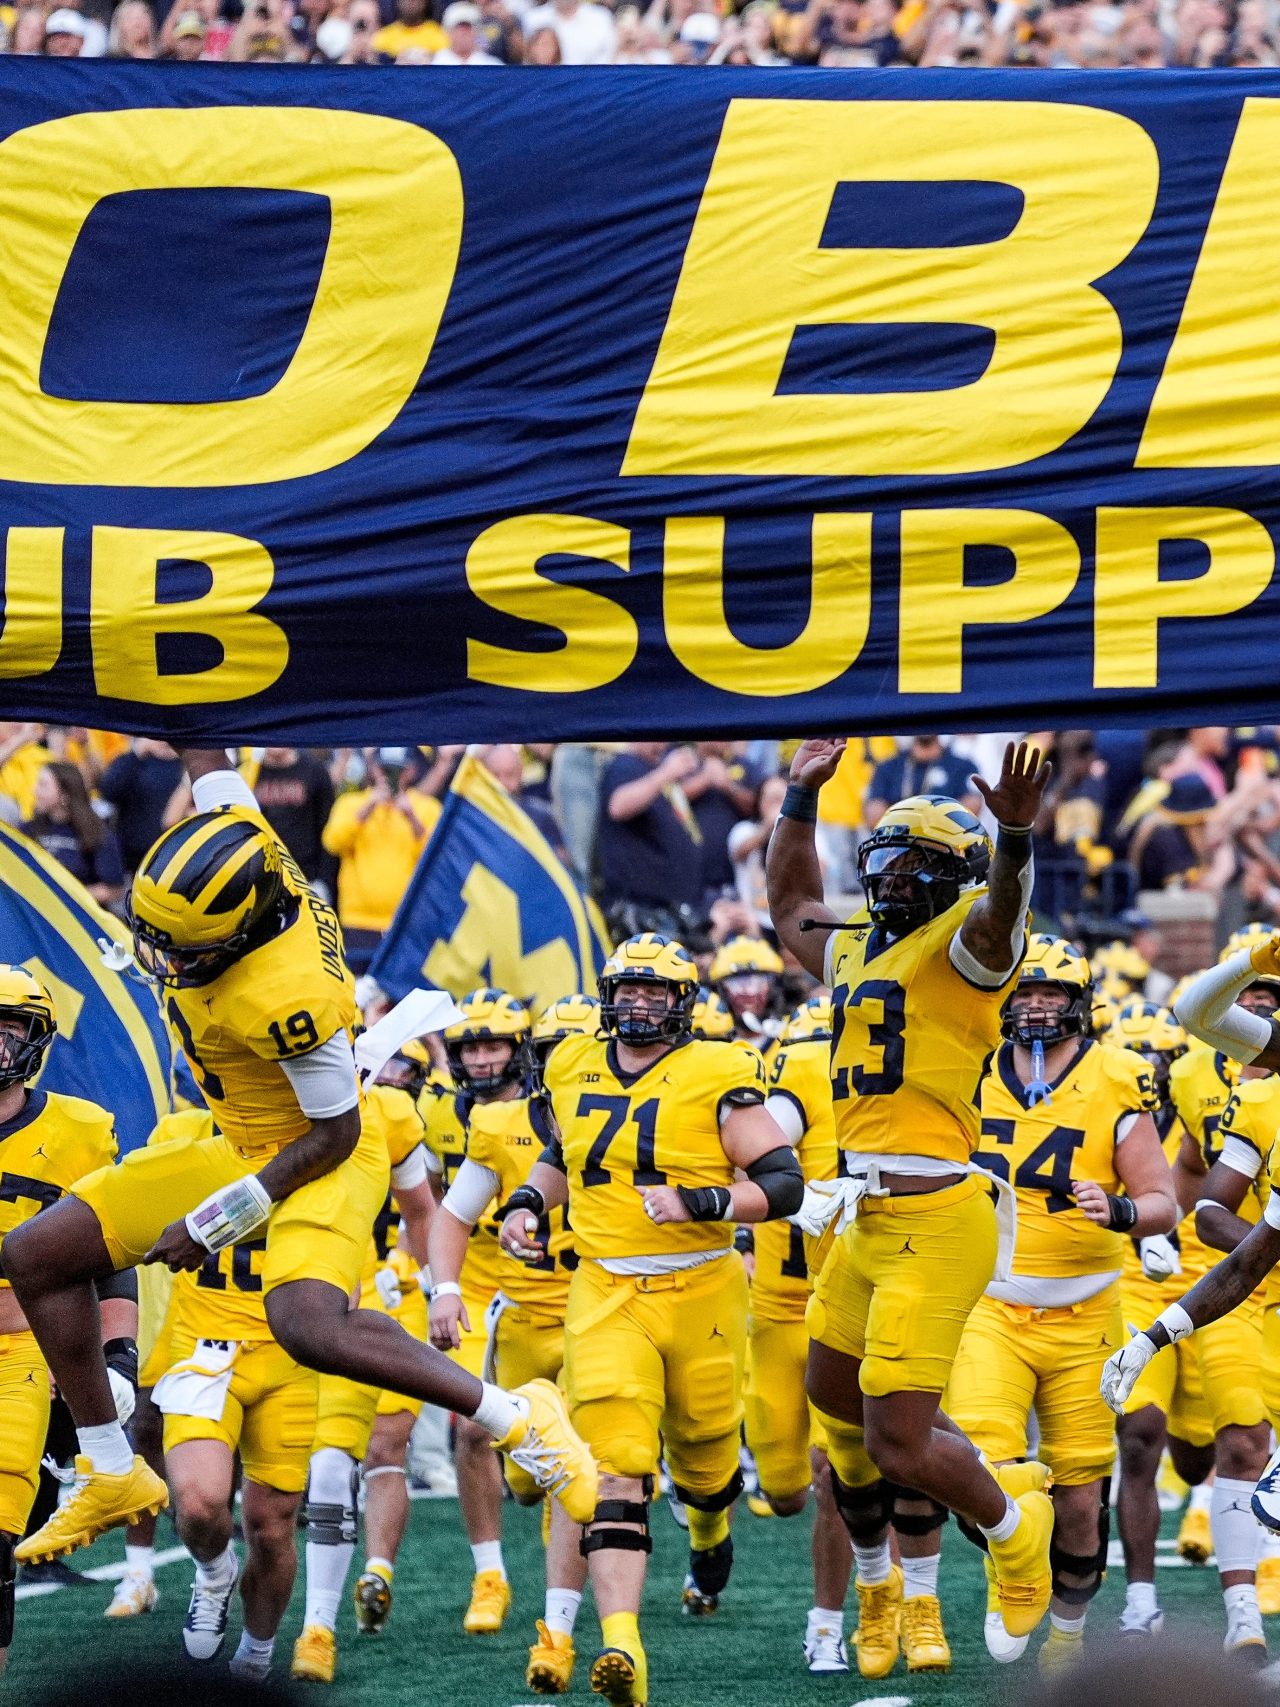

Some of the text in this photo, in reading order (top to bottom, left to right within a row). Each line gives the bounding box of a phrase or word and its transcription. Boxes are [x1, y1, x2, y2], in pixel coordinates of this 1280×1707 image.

[267, 1010, 319, 1056] 19
[575, 1093, 667, 1188] 71
[1222, 1094, 1241, 1129] 6
[970, 1119, 1085, 1213] 54
